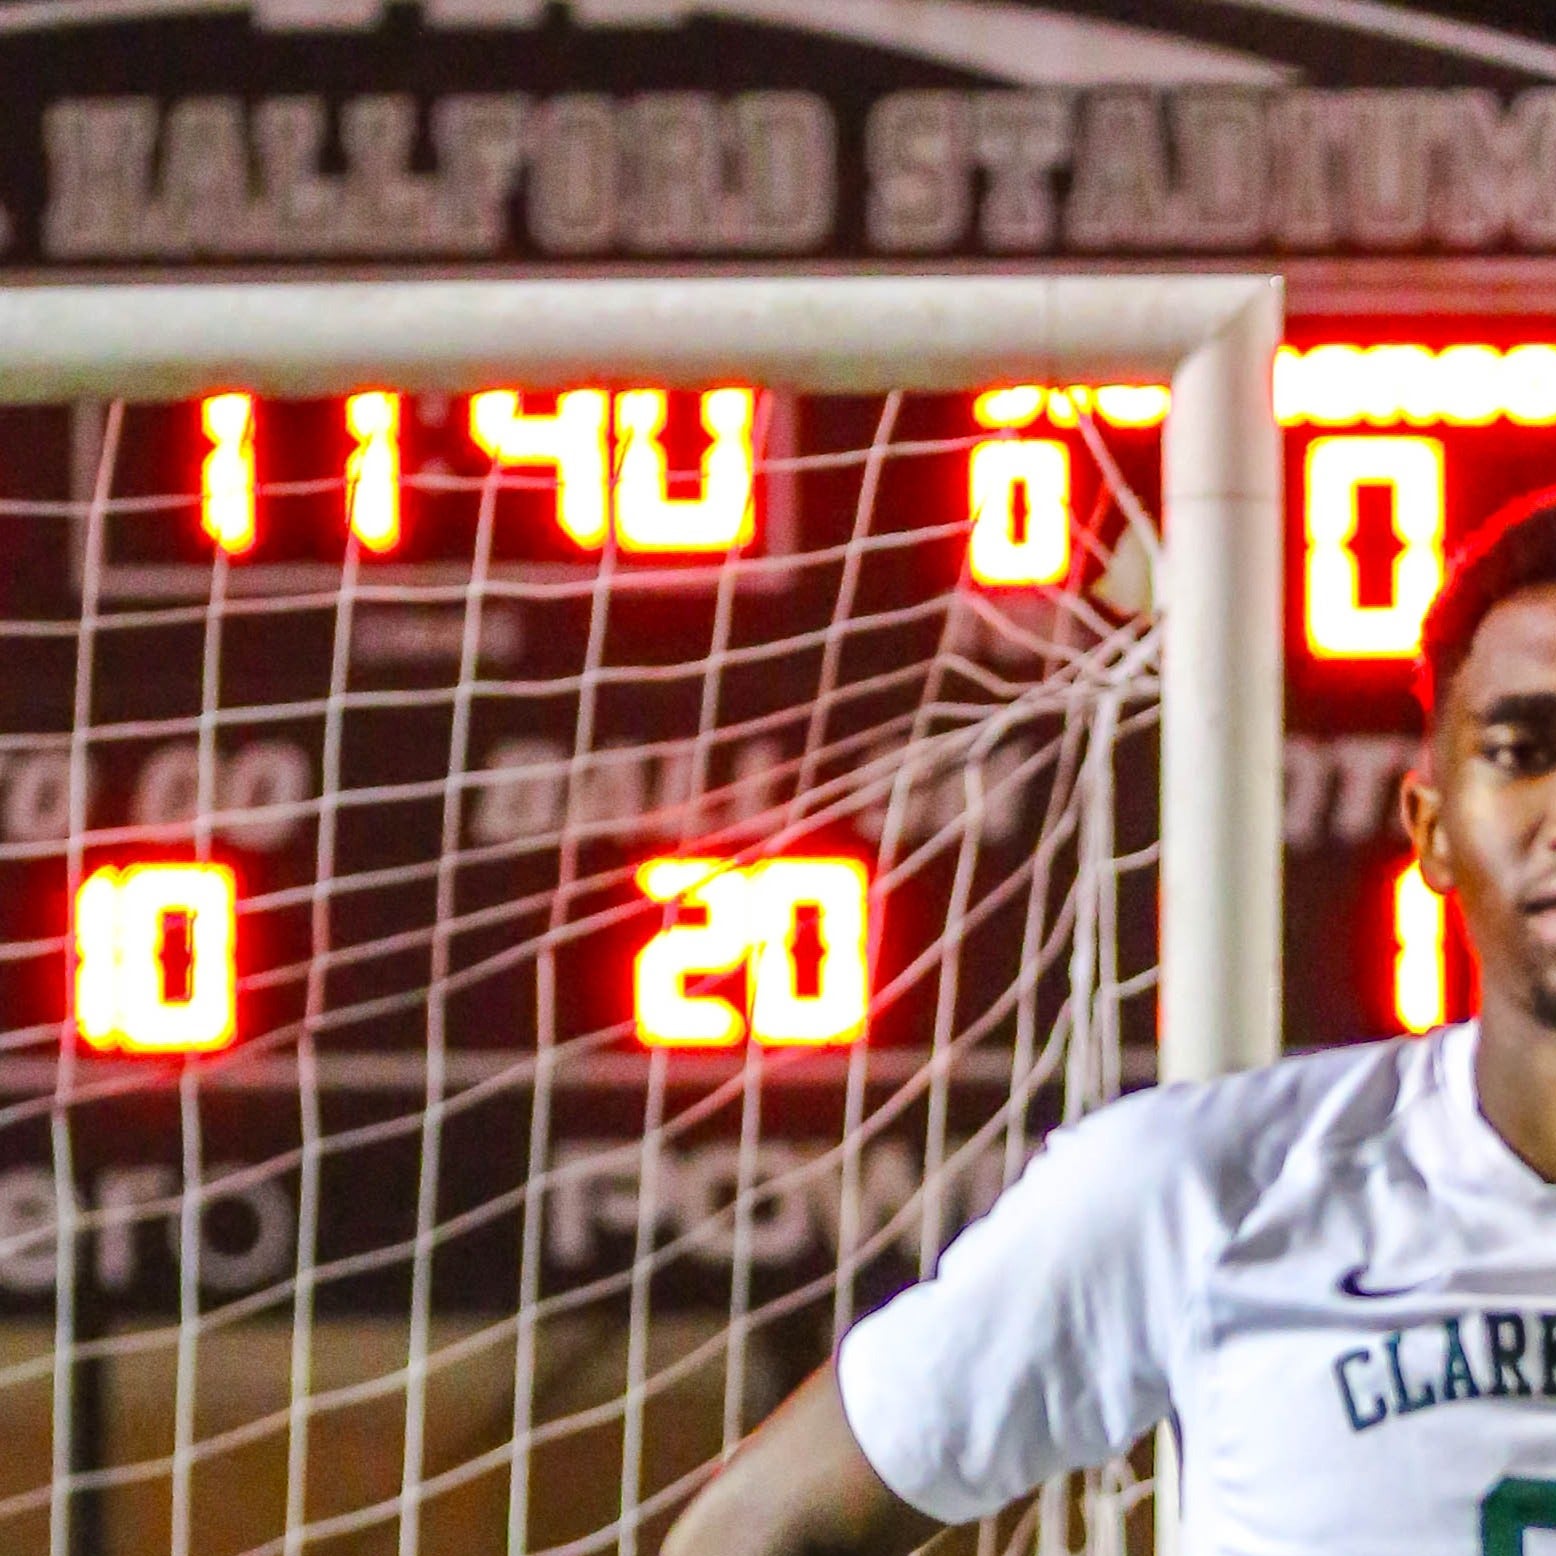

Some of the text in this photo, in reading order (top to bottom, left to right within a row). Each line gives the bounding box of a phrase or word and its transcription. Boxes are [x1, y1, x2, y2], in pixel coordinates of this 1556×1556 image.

[968, 438, 1072, 587] 0
[1304, 434, 1445, 660] 0
[74, 861, 238, 1053] 10
[632, 855, 872, 1048] 20
